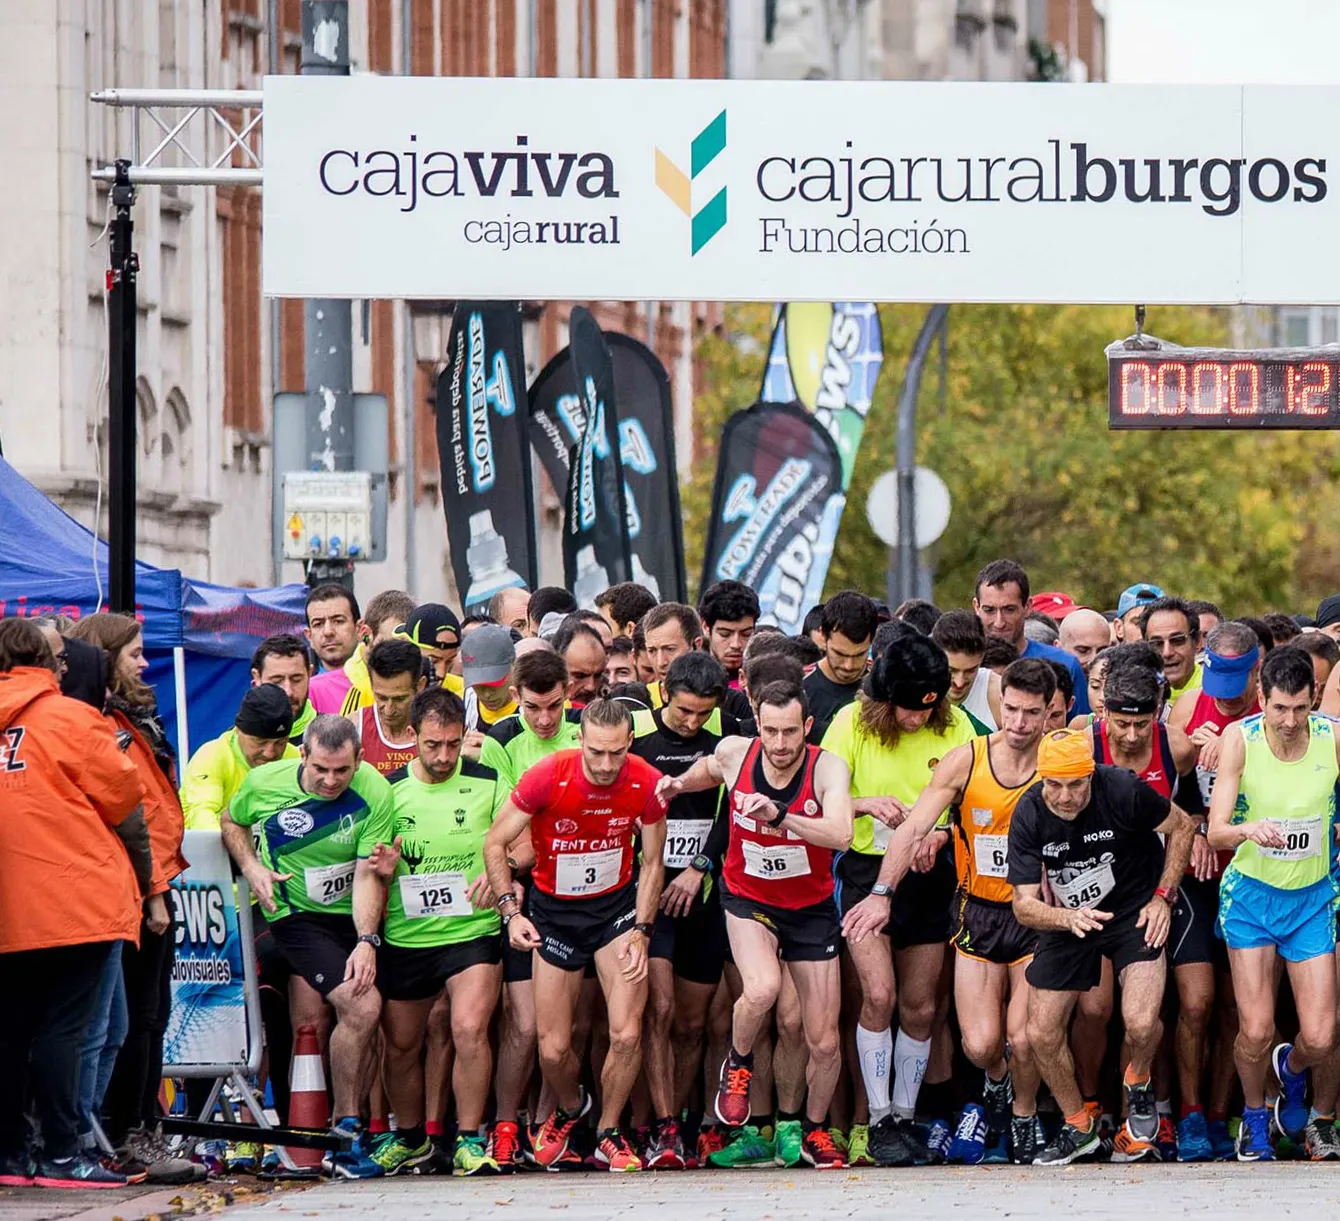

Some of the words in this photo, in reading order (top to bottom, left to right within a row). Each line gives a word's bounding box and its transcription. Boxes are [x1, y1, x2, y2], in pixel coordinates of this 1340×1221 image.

[319, 134, 620, 213] cajaviva
[755, 139, 1329, 218] cajaruralburgos
[463, 214, 621, 251] cajarural
[758, 217, 972, 254] Fundación
[377, 762, 391, 770] DE
[386, 752, 414, 761] VINO
[552, 838, 588, 851] FENT
[667, 836, 701, 856] 1221
[1276, 832, 1310, 851] 00
[762, 857, 787, 872] 36
[585, 867, 597, 884] 3
[419, 887, 453, 908] 125
[1067, 882, 1102, 909] 345
